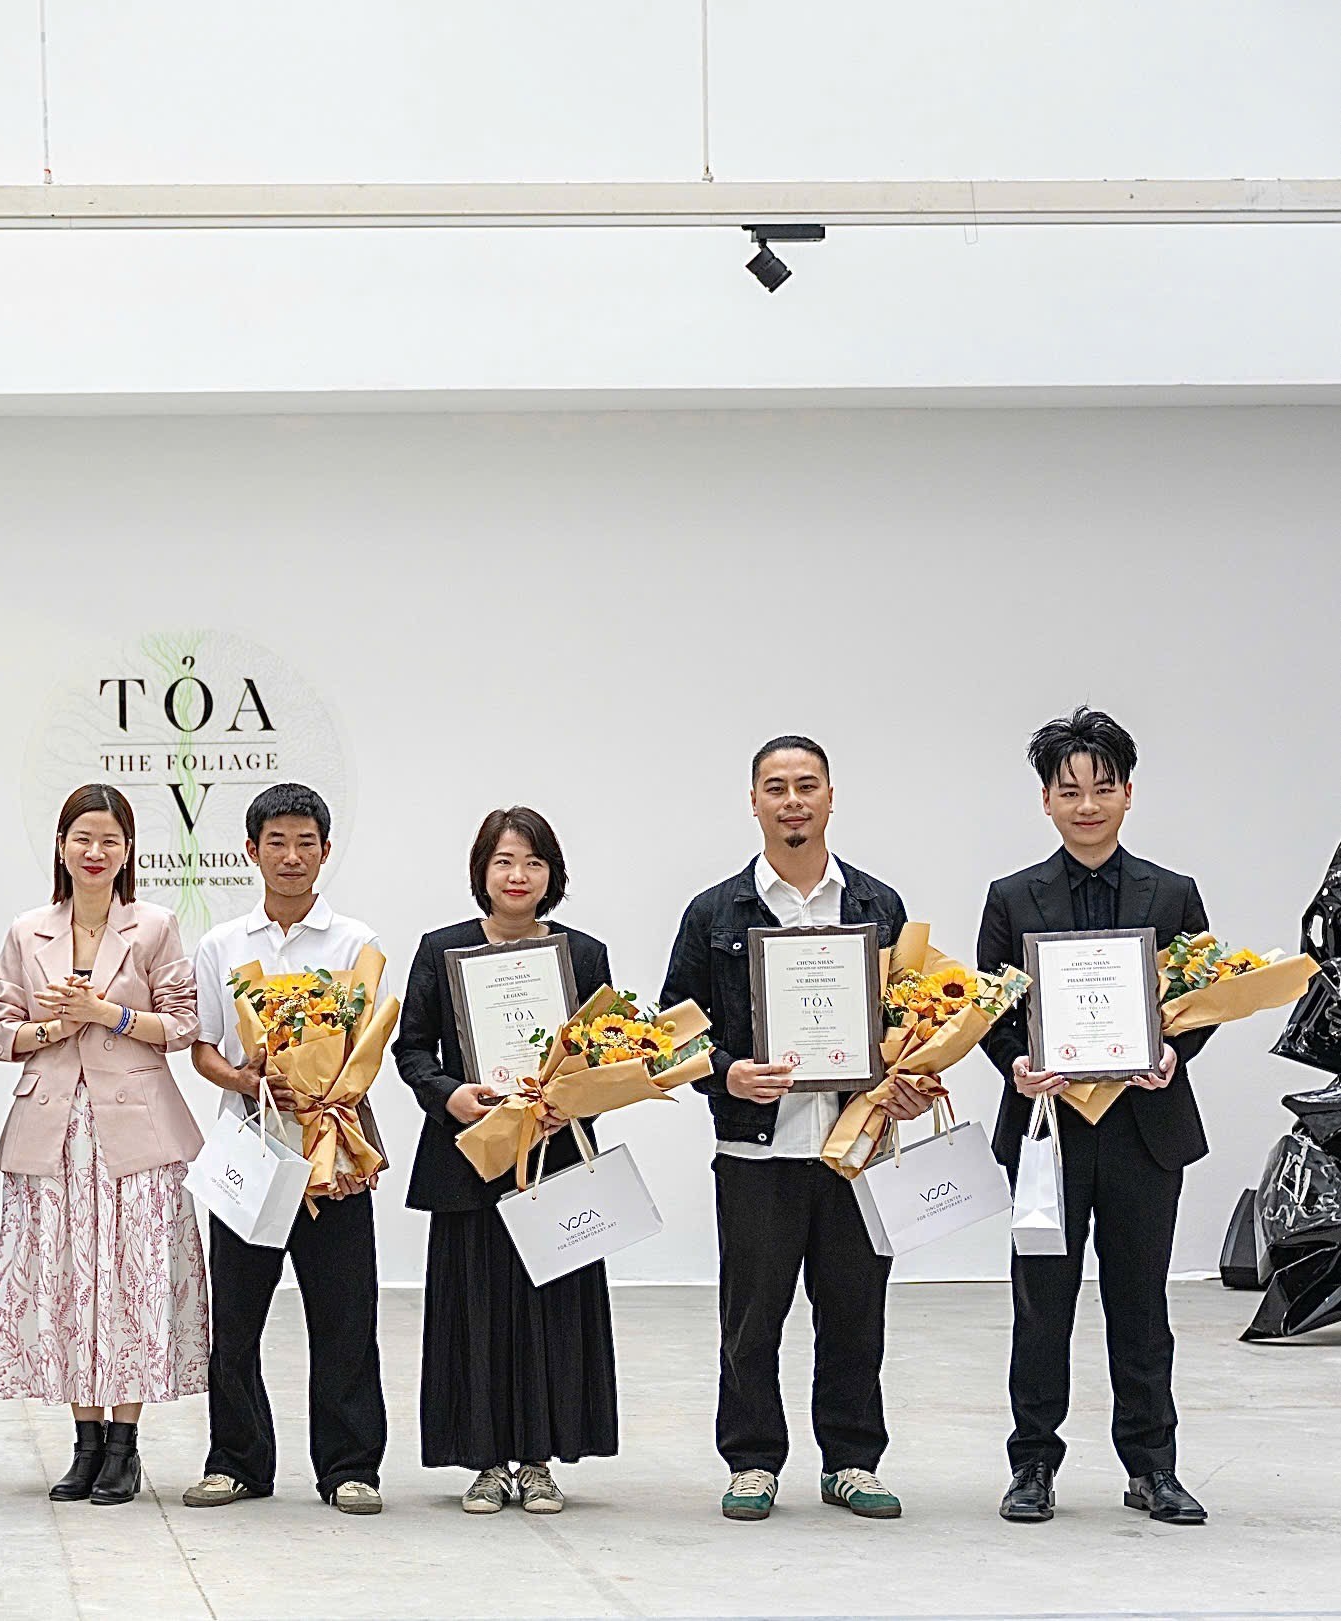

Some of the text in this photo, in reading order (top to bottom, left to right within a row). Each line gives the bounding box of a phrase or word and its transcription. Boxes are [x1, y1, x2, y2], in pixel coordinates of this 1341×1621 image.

[99, 656, 277, 732] TỎA
[100, 753, 279, 772] THE FOLIAGE
[166, 783, 215, 835] V
[138, 853, 249, 872] CHẠM KHOA
[153, 878, 189, 887] TOUCH
[193, 877, 206, 886] OF
[209, 876, 254, 886] SCIENCE
[565, 1221, 605, 1241] VINCOM CENTER
[568, 1226, 607, 1246] CONTEMPORARY
